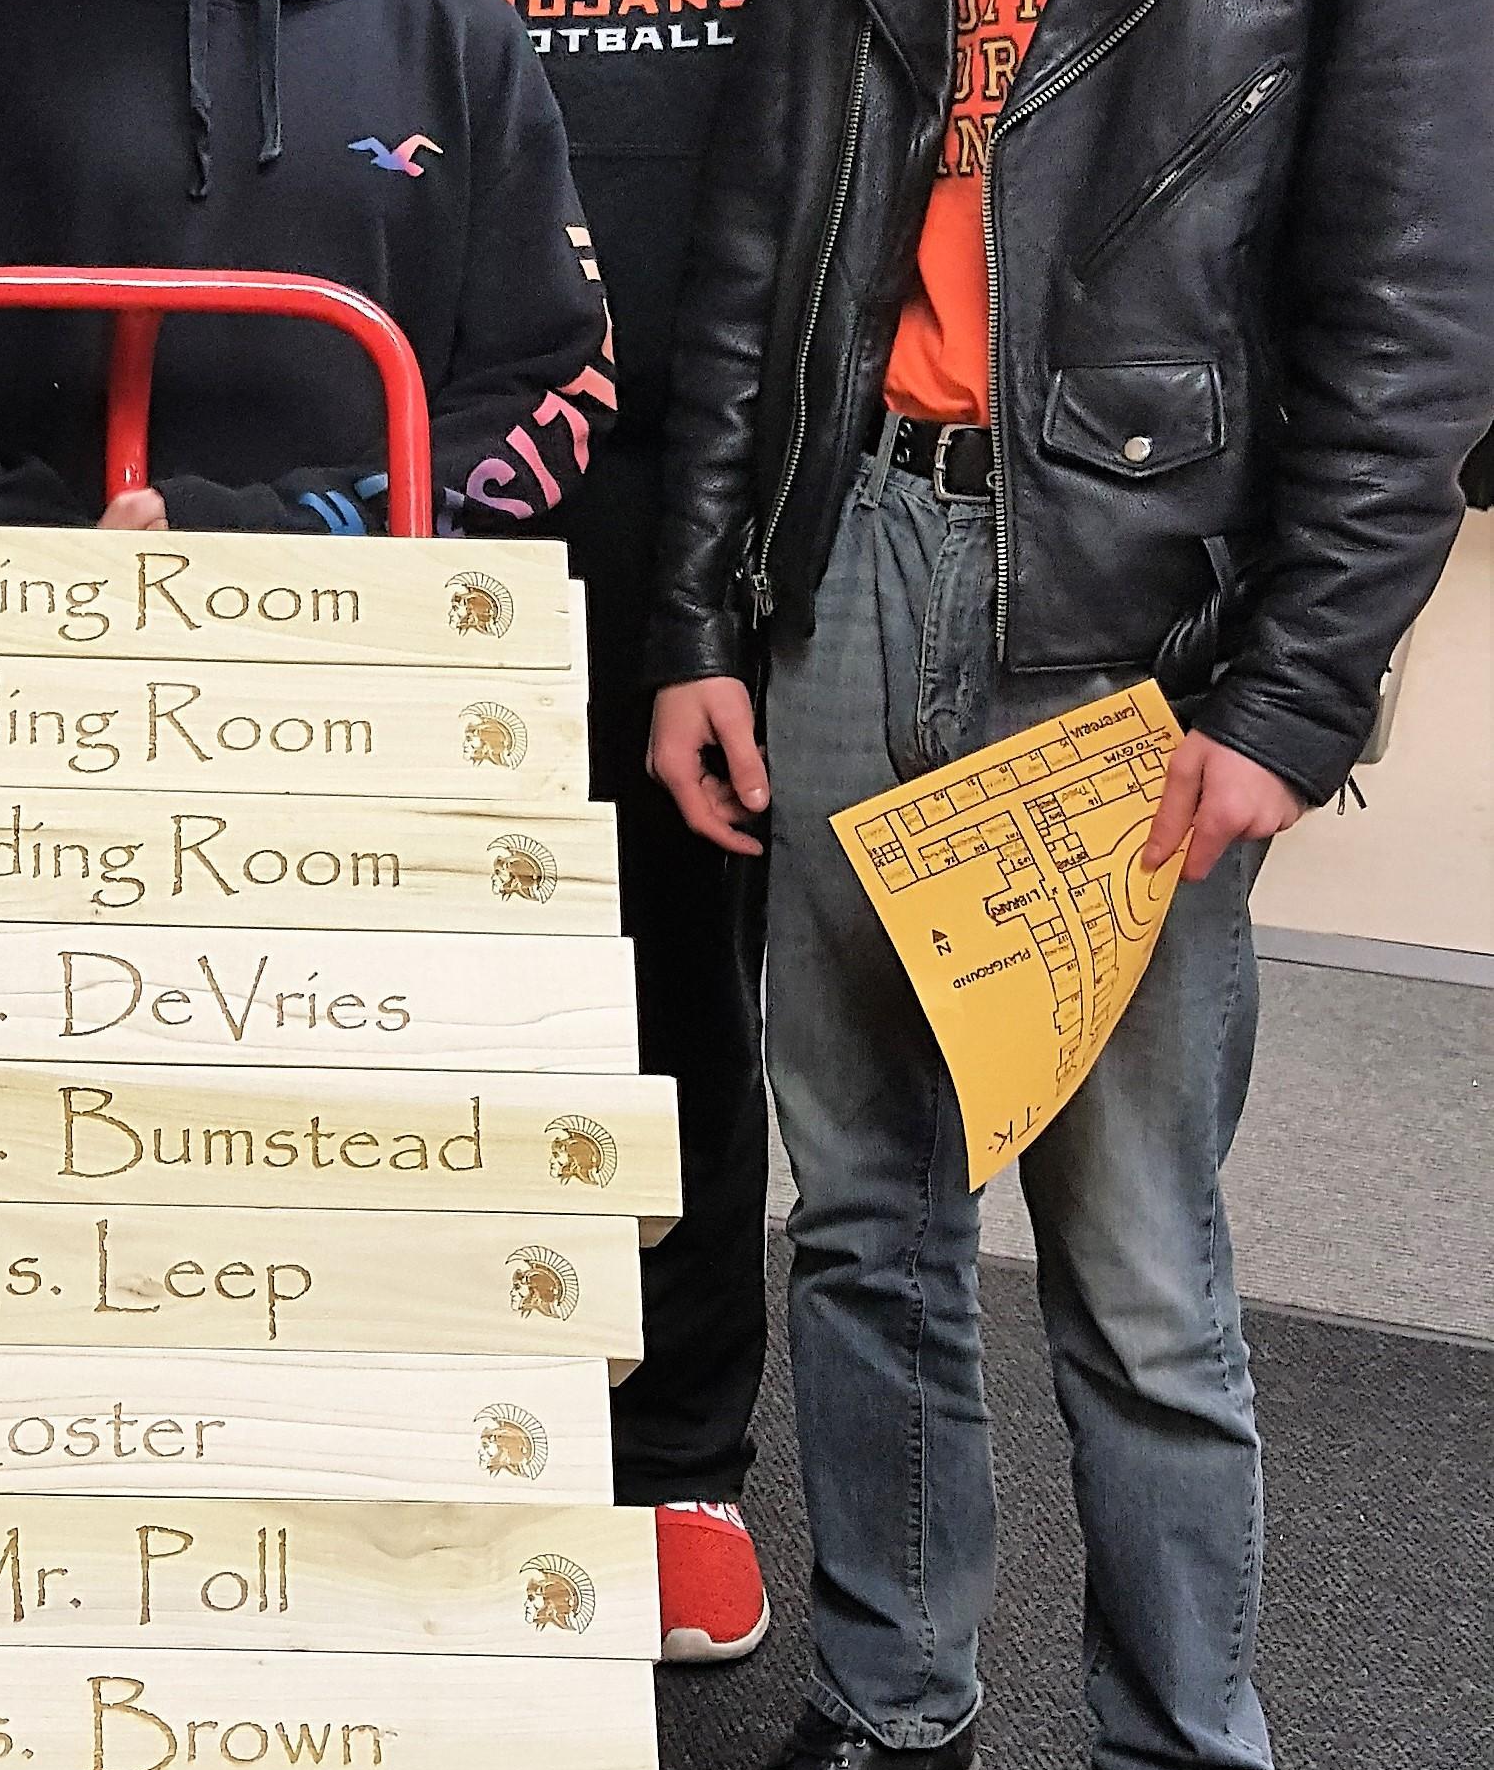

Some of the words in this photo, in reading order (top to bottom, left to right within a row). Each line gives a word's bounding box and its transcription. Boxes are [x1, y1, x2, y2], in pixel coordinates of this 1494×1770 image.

[528, 21, 735, 53] OTBALL
[136, 553, 359, 630] Room
[147, 682, 371, 762] Room
[1103, 746, 1134, 764] GYM
[171, 815, 403, 897] Room
[58, 951, 410, 1041] DeVries
[952, 948, 1031, 990] PLAYGROUND
[58, 1087, 482, 1178] Bumstead
[93, 1219, 312, 1340] Leep
[136, 1525, 288, 1625] Poll
